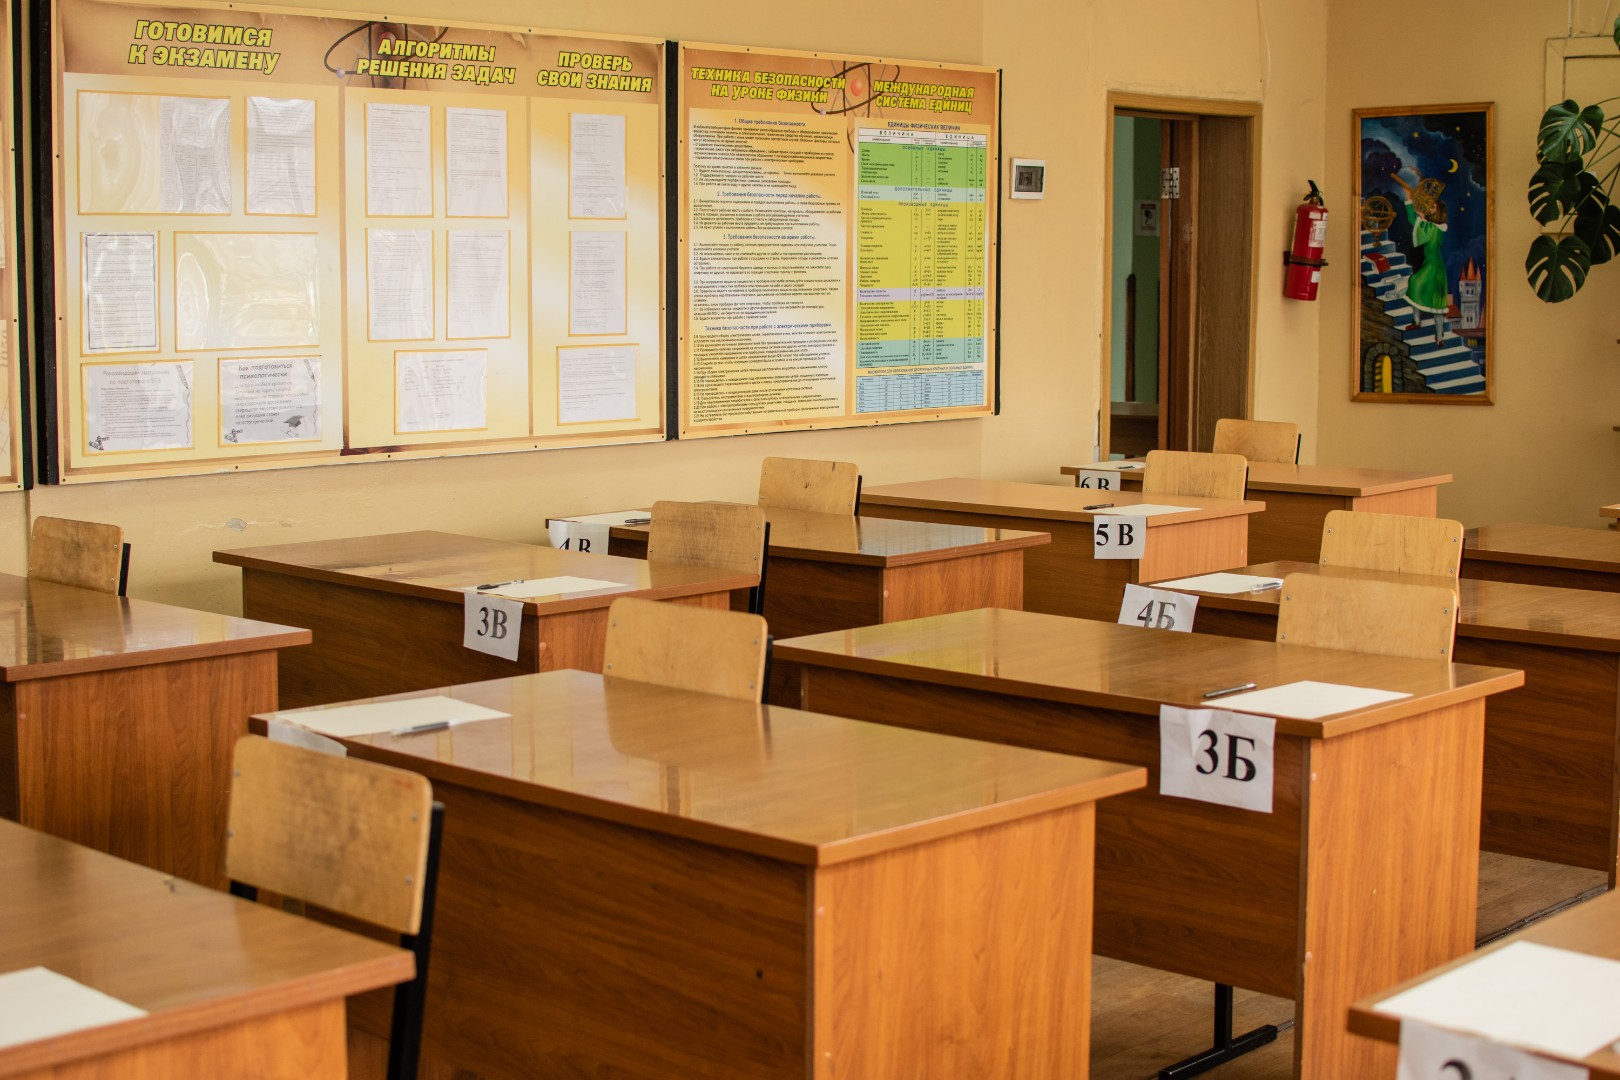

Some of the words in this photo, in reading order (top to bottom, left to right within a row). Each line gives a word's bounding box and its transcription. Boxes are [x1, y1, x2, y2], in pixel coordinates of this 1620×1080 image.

[134, 19, 273, 47] ГОТОВИМСЯ
[127, 44, 148, 65] К
[152, 45, 281, 75] ЭКЗАМЕНУ
[377, 38, 496, 62] АЛГОРИТМЫ
[557, 50, 633, 72] ПРОВЕРЬ
[356, 58, 447, 81] РЕШЕНИЯ
[451, 64, 516, 86] ЗАДАЧ
[536, 70, 584, 89] СВОИ
[586, 74, 653, 93] ЗНАНИЯ
[690, 67, 751, 84] ТЕХНИКА
[753, 71, 846, 90] БЕЗОПАСНОСТИ
[710, 83, 729, 98] НА
[732, 84, 773, 101] УРОКЕ
[775, 88, 829, 104] ФИЗИКИ
[872, 80, 975, 100] МЕЖДУНАРОДНАЯ
[875, 95, 927, 111] СИСТЕМА
[928, 97, 974, 115] ЕДИНИЦ
[888, 121, 909, 129] ЕДИНИЦЫ
[1081, 477, 1090, 489] 6
[1097, 477, 1110, 491] В
[1095, 523, 1109, 546] 5
[1117, 523, 1134, 546] В
[477, 606, 508, 640] 3В
[1136, 599, 1177, 631] 4Б
[1195, 729, 1257, 782] 3Б
